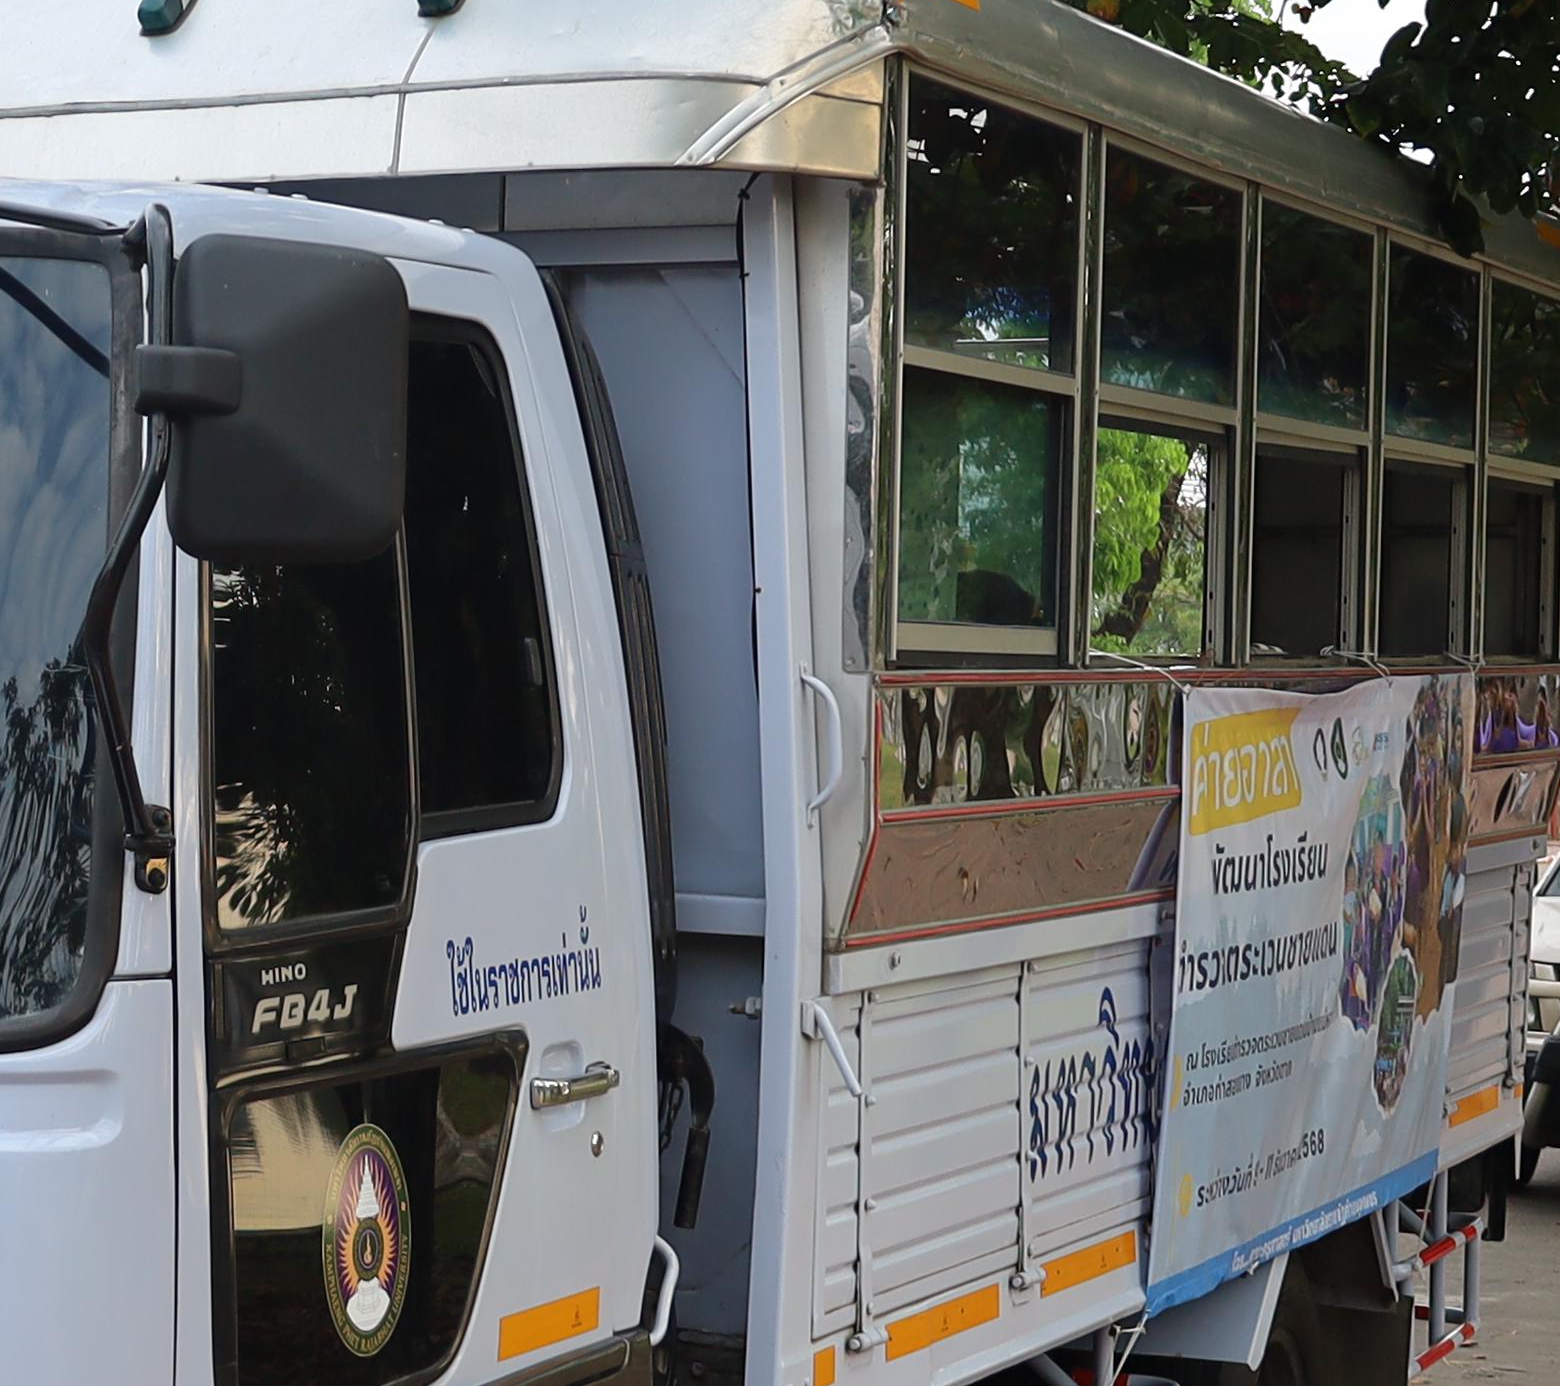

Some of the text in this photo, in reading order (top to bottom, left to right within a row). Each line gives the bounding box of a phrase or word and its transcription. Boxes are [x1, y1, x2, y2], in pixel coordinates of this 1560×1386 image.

[261, 963, 307, 986] HINO
[446, 904, 602, 1017] ใช้ในราชการเท่านั้น
[251, 984, 358, 1034] FB4J
